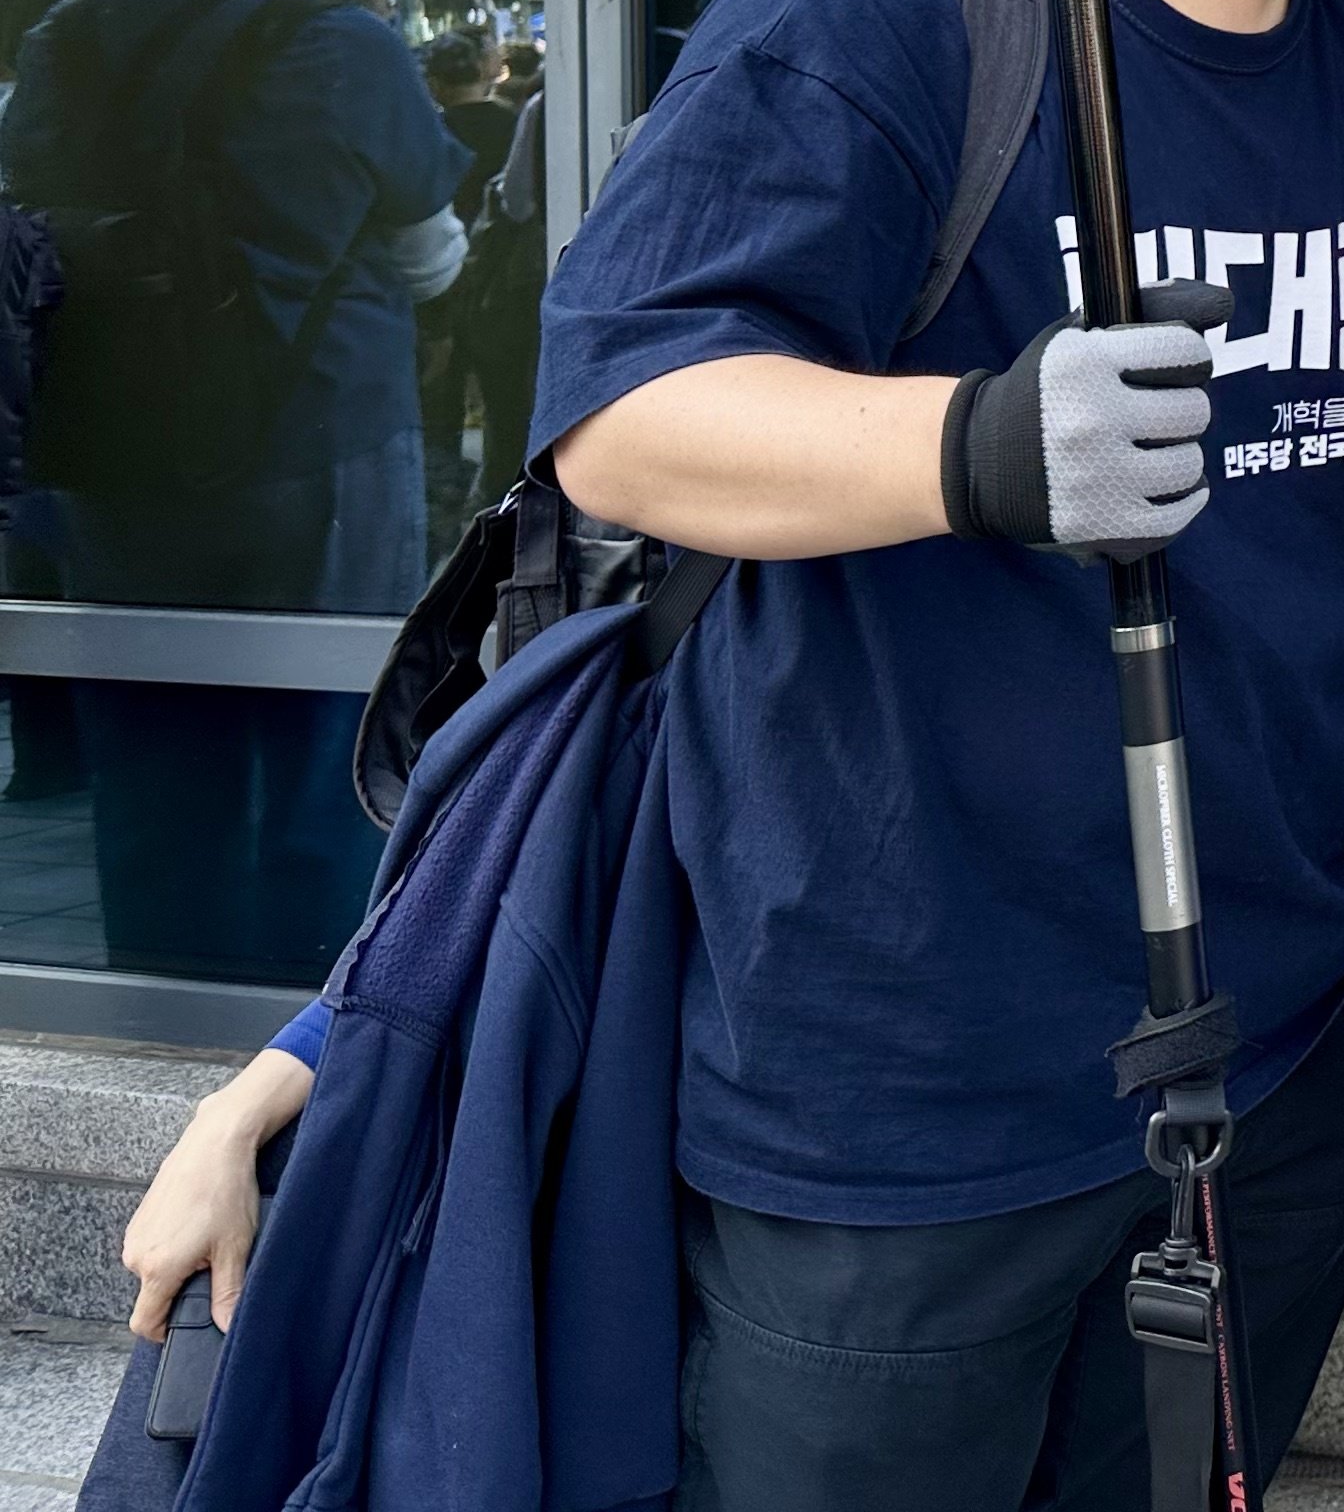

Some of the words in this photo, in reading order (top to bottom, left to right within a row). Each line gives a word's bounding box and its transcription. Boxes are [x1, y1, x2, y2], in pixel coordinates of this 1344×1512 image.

[1224, 437, 1293, 479] 민주당
[1162, 829, 1176, 865] CLOTH
[1165, 866, 1179, 908] SPECIAL
[1202, 1183, 1216, 1255] PERFORMANCE
[1218, 1334, 1228, 1378] CARBON
[1221, 1379, 1233, 1429] LANDING
[1227, 1430, 1236, 1450] NET
